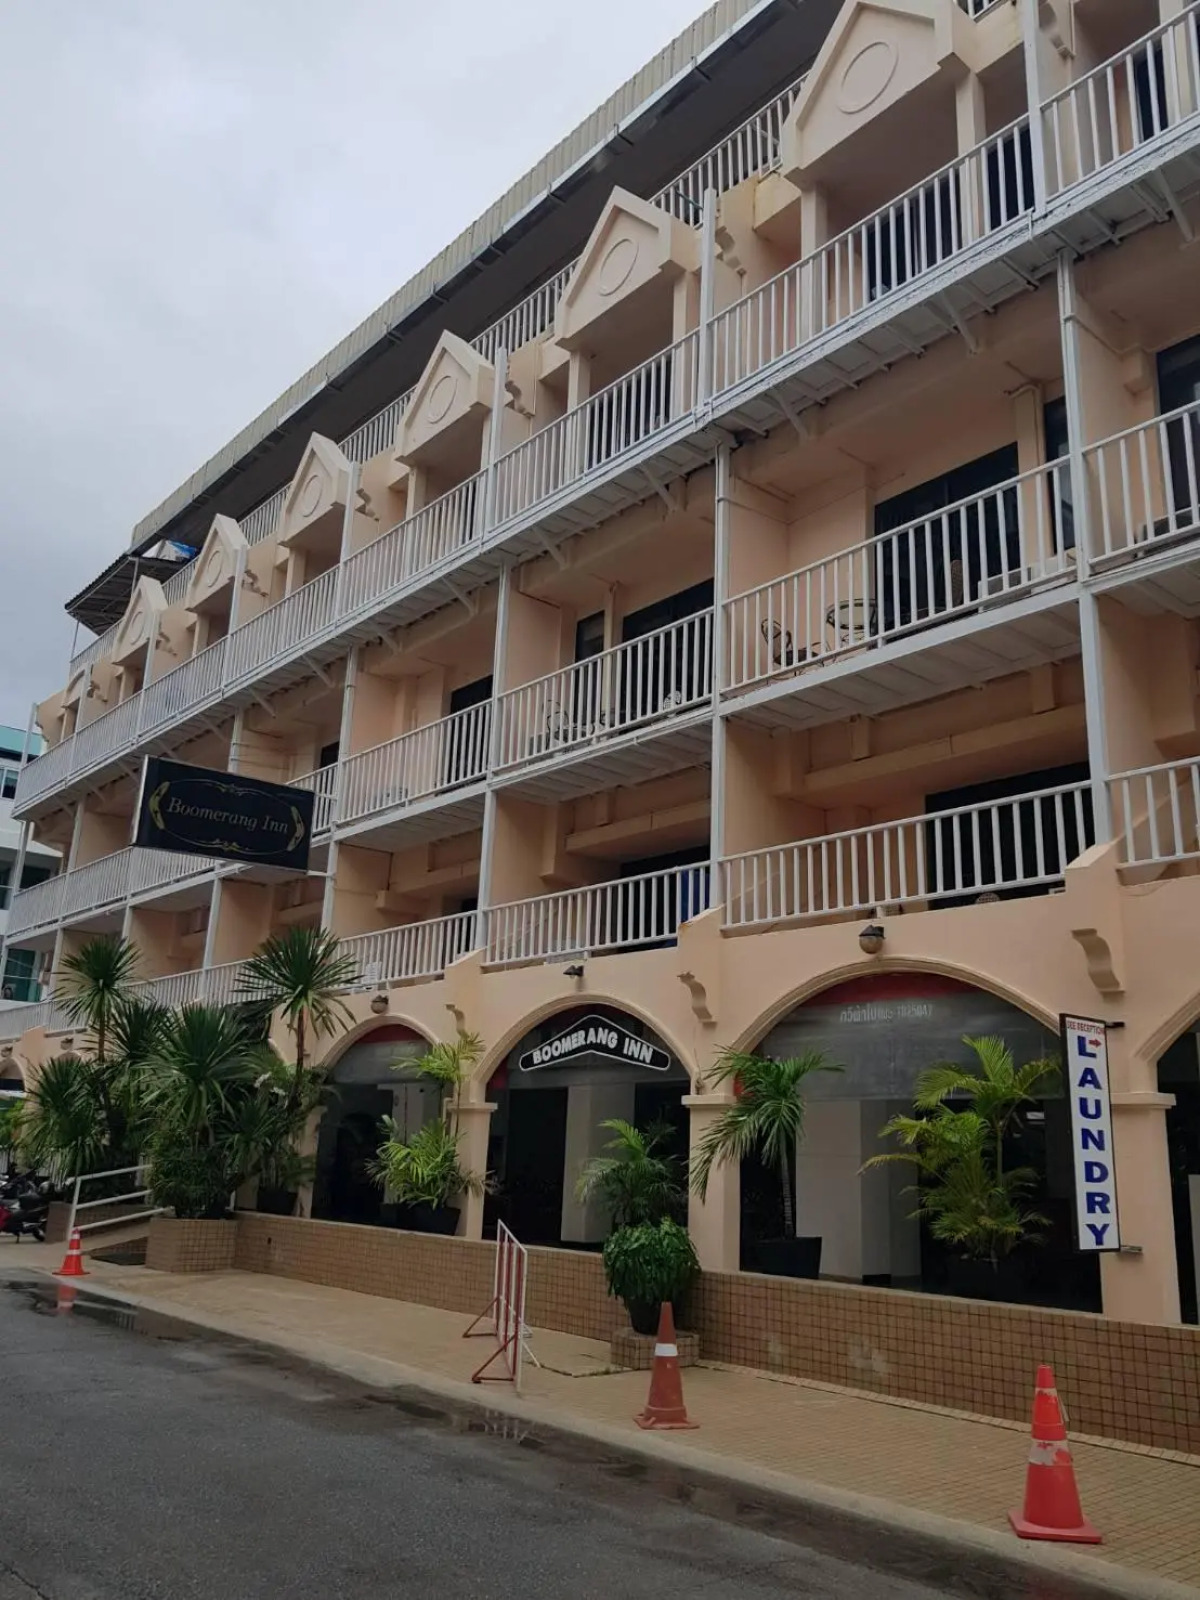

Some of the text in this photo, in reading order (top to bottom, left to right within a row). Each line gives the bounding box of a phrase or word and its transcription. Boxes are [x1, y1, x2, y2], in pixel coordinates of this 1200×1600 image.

[166, 796, 289, 835] Boomerang Inn
[532, 1027, 654, 1065] BOOMERANG INN
[1077, 1035, 1111, 1246] LAUNDRY
